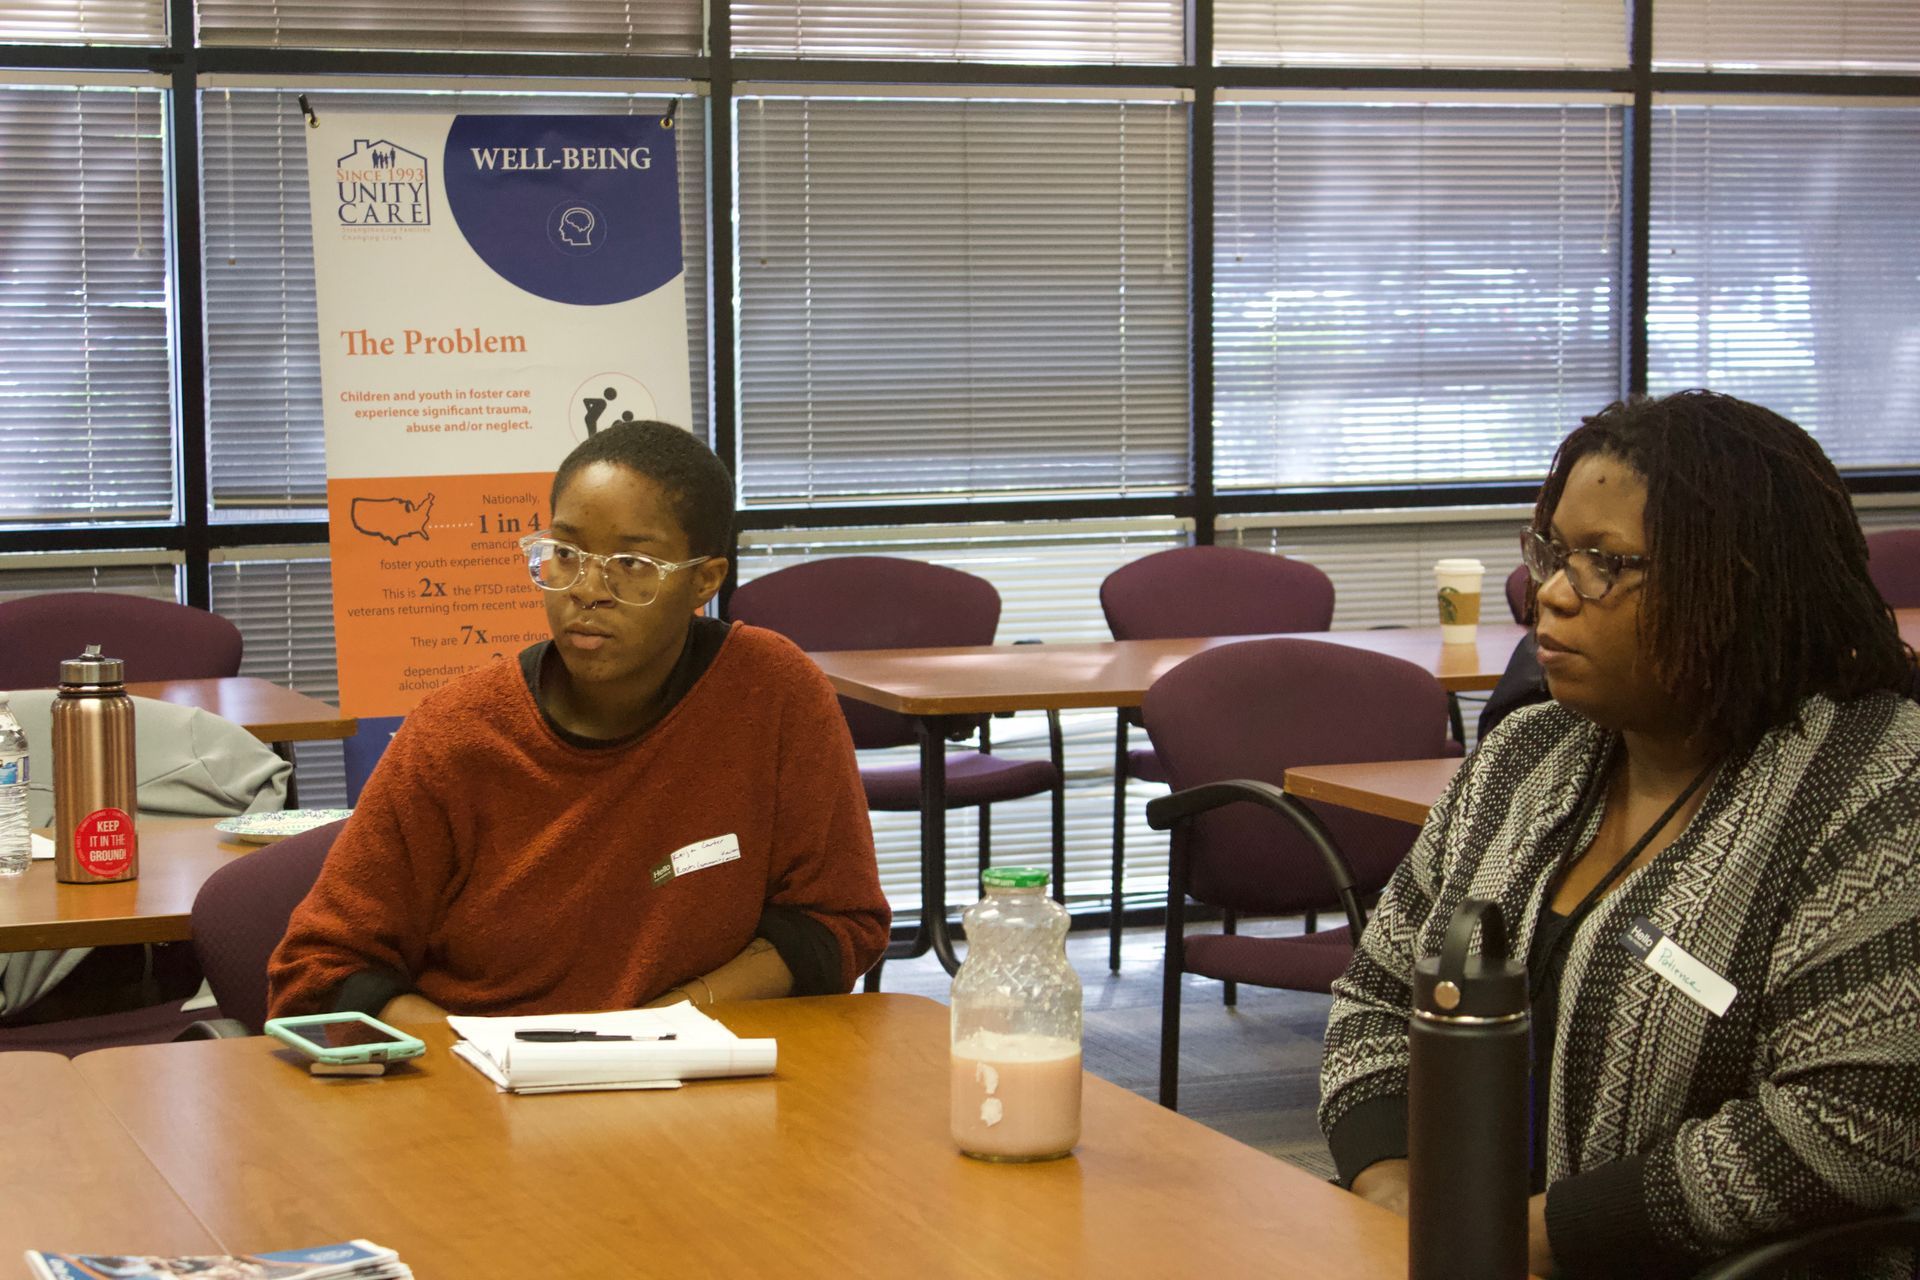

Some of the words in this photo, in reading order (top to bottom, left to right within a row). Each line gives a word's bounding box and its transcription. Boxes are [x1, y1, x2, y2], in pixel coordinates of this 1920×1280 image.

[470, 147, 652, 170] WELL-BEING
[336, 168, 381, 181] SINCE
[389, 168, 424, 181] 1993
[337, 182, 423, 203] UNITY
[338, 203, 423, 223] CARE
[340, 330, 395, 355] The
[403, 328, 528, 354] Problem
[340, 391, 390, 402] Children
[393, 390, 416, 401] and
[419, 389, 453, 403] youth
[455, 389, 467, 400] in
[469, 388, 503, 399] foster
[506, 389, 531, 398] care
[354, 406, 420, 420] experience
[422, 405, 484, 419] significant
[486, 404, 532, 415] trauma,
[406, 422, 441, 433] abuse
[444, 421, 483, 432] and/or
[485, 420, 533, 433] neglect.
[482, 493, 540, 505] Nationally,
[479, 513, 489, 533] 1
[498, 512, 521, 533] in
[527, 511, 541, 531] 4
[471, 538, 519, 550] emancip
[380, 559, 412, 570] foster
[415, 557, 448, 571] youth
[450, 555, 511, 568] experience
[382, 588, 406, 599] This
[408, 587, 416, 598] is
[418, 577, 448, 597] 2x
[453, 585, 472, 596] the
[474, 584, 503, 595] PTSD
[506, 584, 532, 593] rates
[347, 606, 395, 617] veterans
[398, 603, 450, 616] returning
[452, 602, 479, 613] from
[481, 600, 517, 611] recent
[410, 636, 438, 649] They
[440, 636, 458, 646] are
[460, 625, 489, 645] 7x
[491, 633, 520, 643] more
[403, 664, 465, 678] dependant
[398, 679, 440, 691] alcohol
[97, 820, 119, 832] KEEP
[89, 835, 98, 848] IT
[100, 835, 109, 847] IN
[111, 833, 126, 846] THE
[89, 848, 127, 862] GROUND!
[653, 864, 672, 879] Hello
[1630, 925, 1654, 948] Hello
